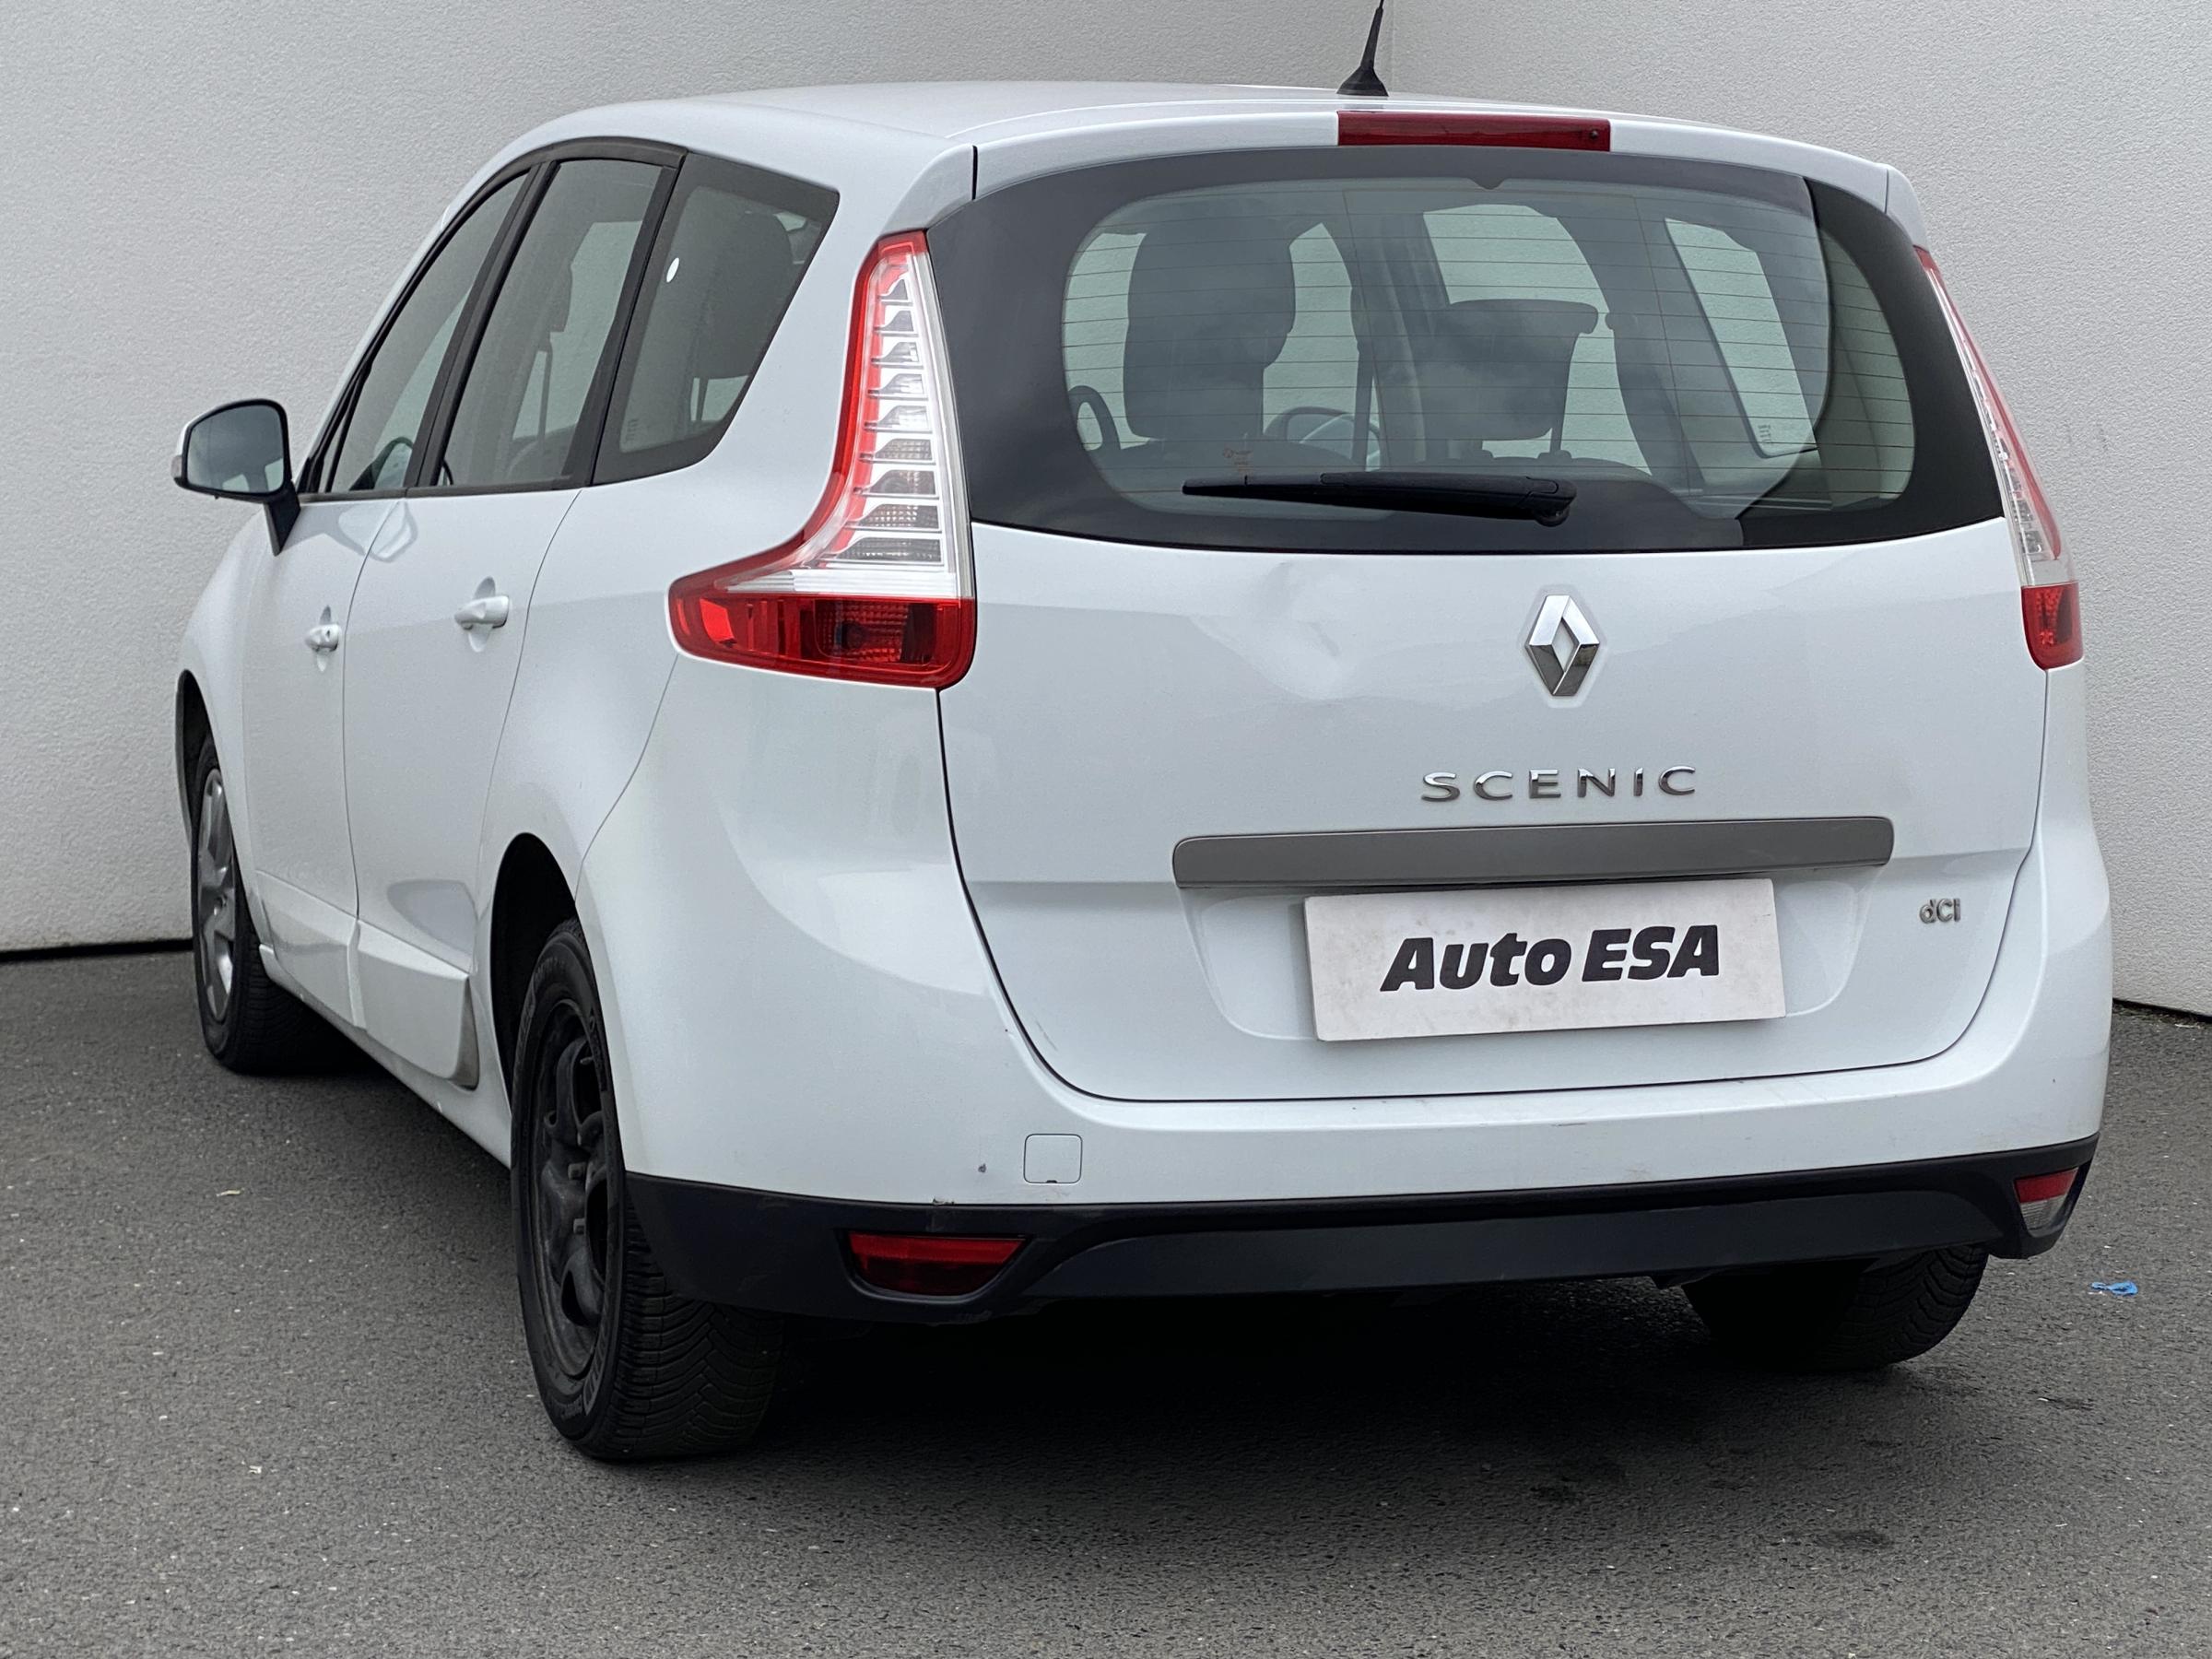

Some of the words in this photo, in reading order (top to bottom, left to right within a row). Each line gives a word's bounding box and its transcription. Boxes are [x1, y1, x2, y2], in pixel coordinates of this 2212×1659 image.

[1421, 765, 1696, 802] SCENIC
[1380, 932, 1571, 992] Auto
[1582, 924, 1720, 982] ESA
